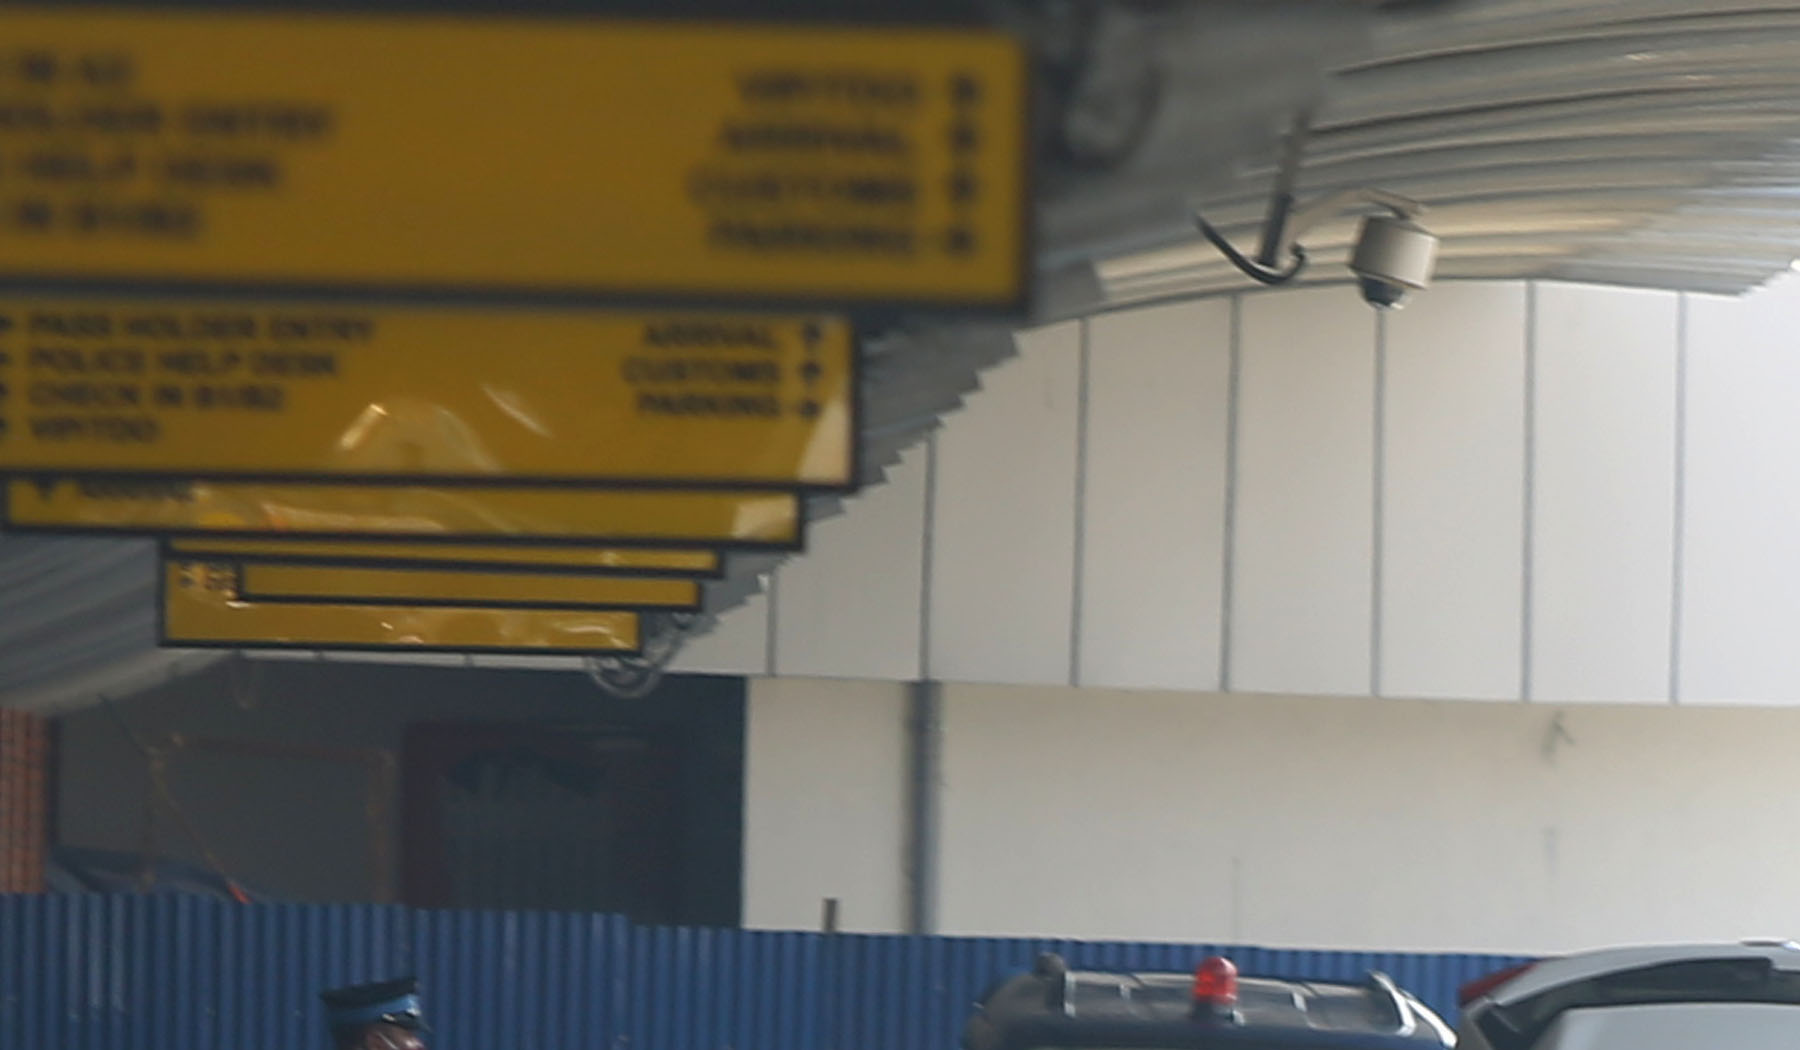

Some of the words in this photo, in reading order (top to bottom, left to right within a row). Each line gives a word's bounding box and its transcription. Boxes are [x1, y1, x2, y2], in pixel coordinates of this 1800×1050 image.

[124, 314, 259, 338] HOLDER
[268, 316, 376, 342] ENTRY
[643, 322, 780, 348] ARRIVAL
[28, 346, 147, 372] POLICE
[154, 350, 243, 375] HELP
[251, 351, 341, 377] DESK
[620, 357, 782, 386] CUSTOMS
[28, 381, 141, 408] CHECK
[635, 394, 782, 419] PARKING
